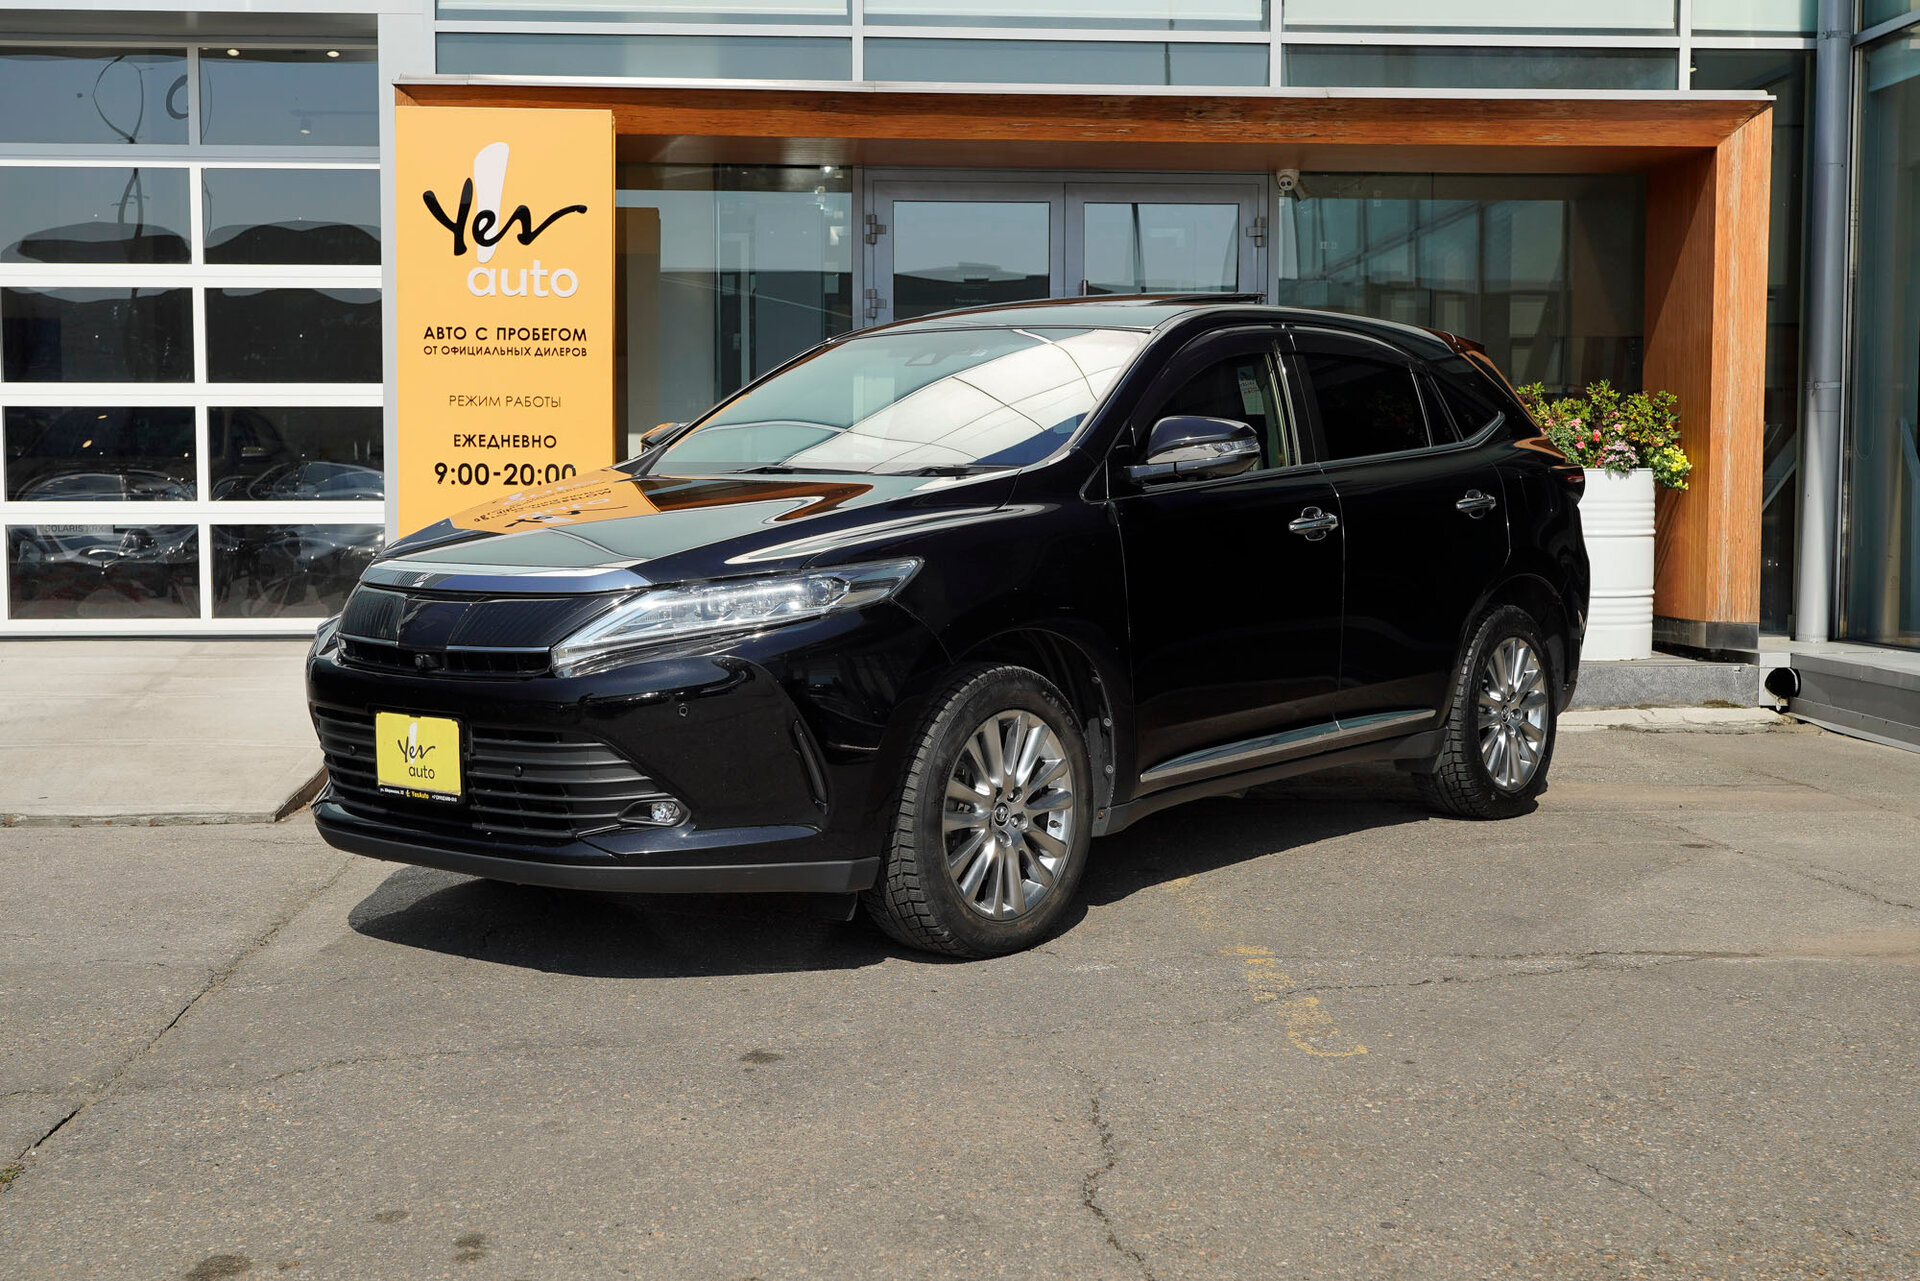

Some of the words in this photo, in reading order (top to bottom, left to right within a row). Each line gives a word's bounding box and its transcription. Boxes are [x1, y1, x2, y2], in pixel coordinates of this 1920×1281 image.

[422, 177, 588, 256] Yes
[466, 260, 579, 298] auto
[423, 326, 467, 340] АВТО
[475, 327, 488, 340] С
[496, 327, 587, 341] ПРОБЕГОМ
[423, 345, 438, 355] ОТ
[441, 345, 532, 357] ОФИЦИАЛЬНЫХ
[534, 347, 588, 357] ДИЛЕРОВ
[449, 394, 501, 407] РЕЖИМ
[505, 395, 562, 408] РАБОТЫ
[453, 434, 557, 449] ЕЖЕДНЕВНО
[397, 735, 436, 763] Yes
[408, 765, 436, 779] auto
